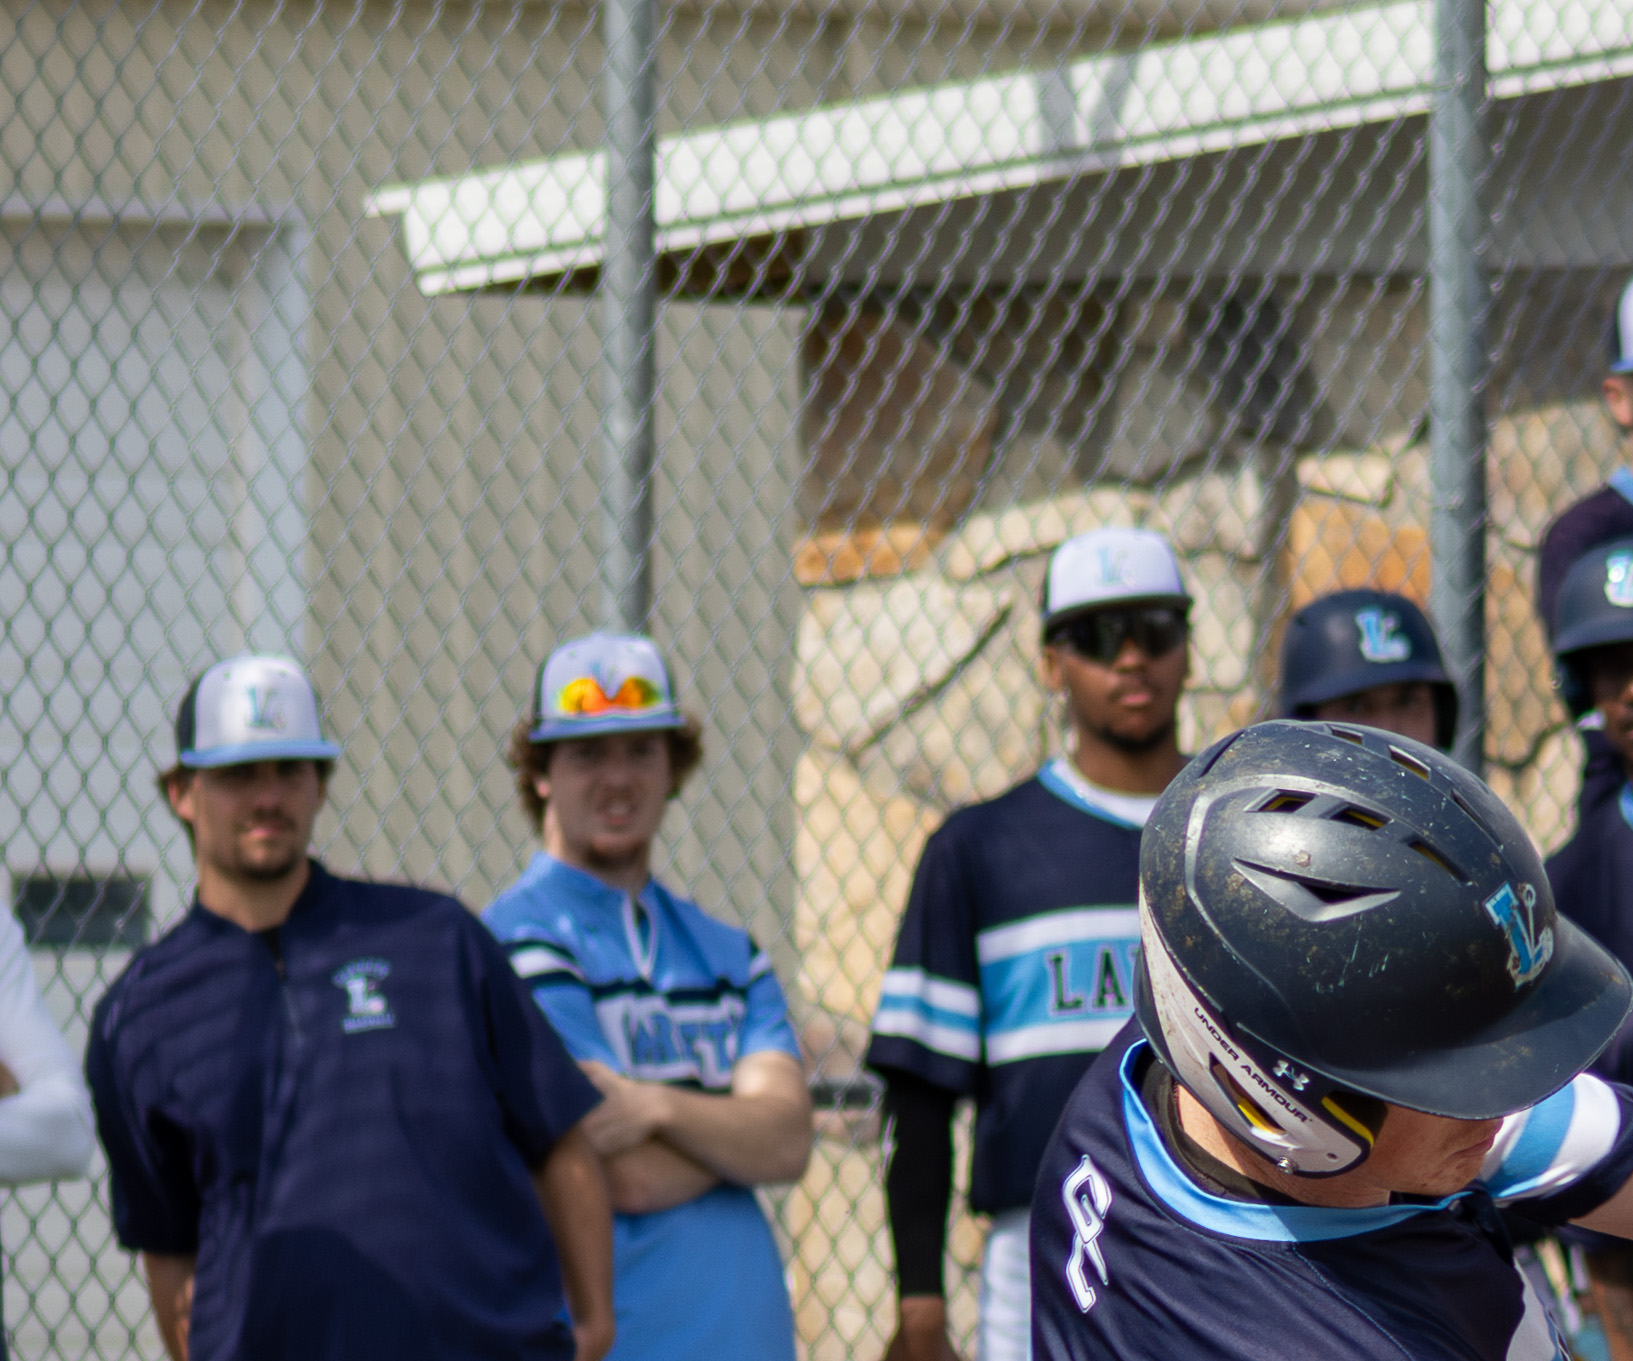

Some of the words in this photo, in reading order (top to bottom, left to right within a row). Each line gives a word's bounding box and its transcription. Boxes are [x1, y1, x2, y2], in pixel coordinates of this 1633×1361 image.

[1044, 943, 1140, 1017] LA
[1194, 1007, 1240, 1062] UNDER
[1240, 1063, 1308, 1123] ARMOUR
